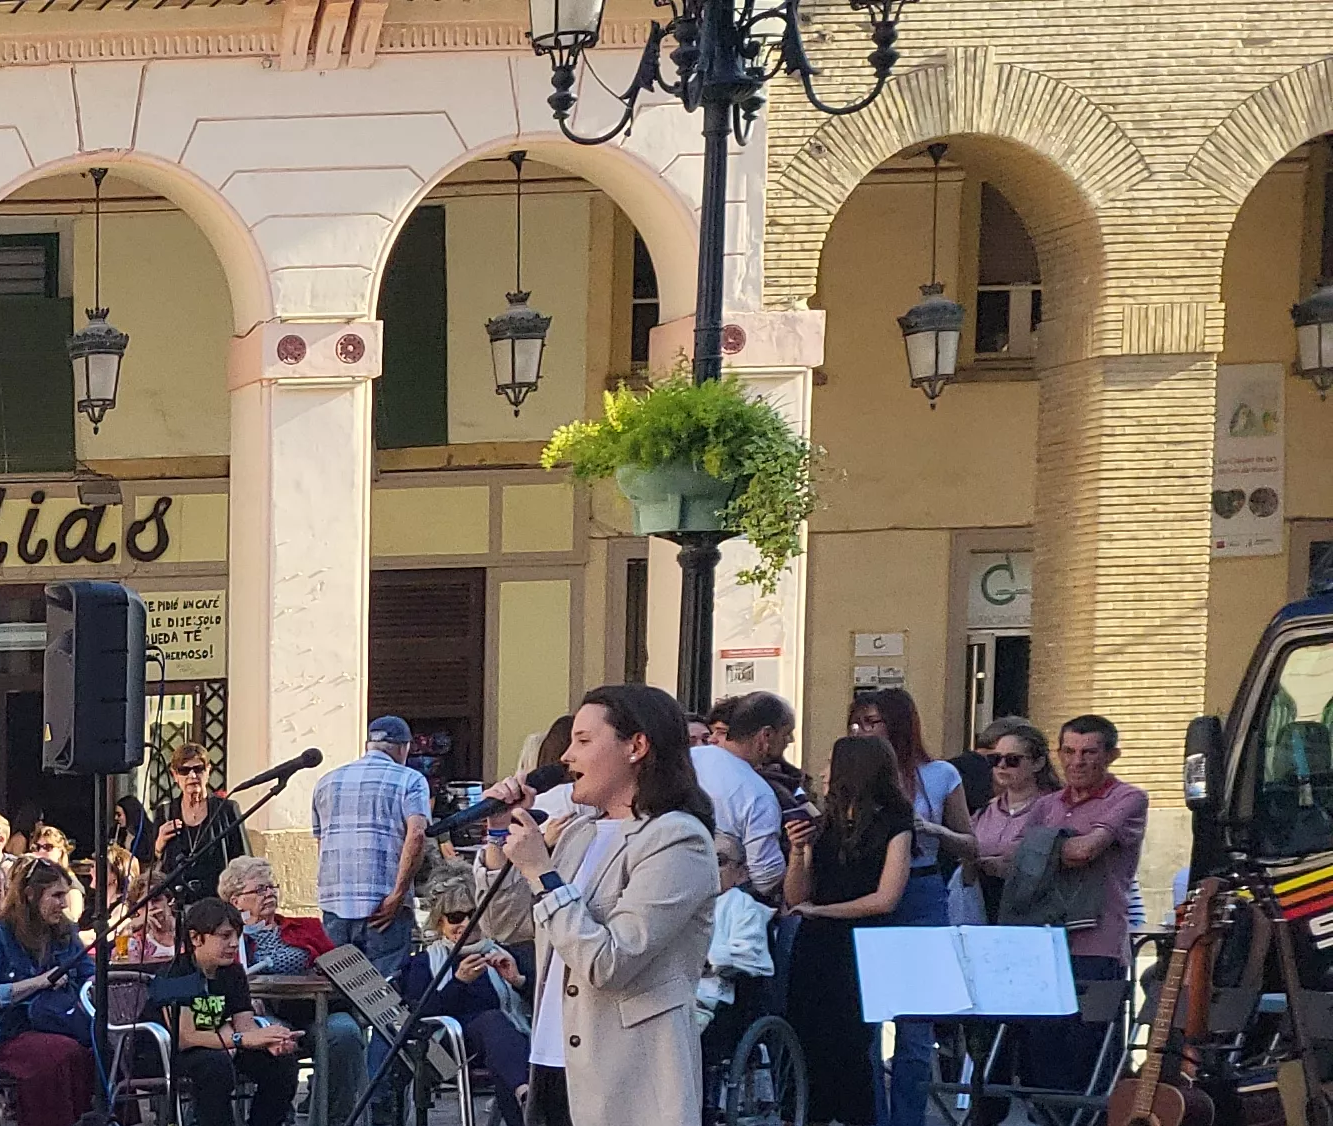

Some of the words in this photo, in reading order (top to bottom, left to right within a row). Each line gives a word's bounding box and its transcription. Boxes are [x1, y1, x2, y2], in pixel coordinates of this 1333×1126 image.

[183, 600, 194, 611] UN
[195, 595, 220, 610] CAFÉ
[151, 617, 162, 629] LE
